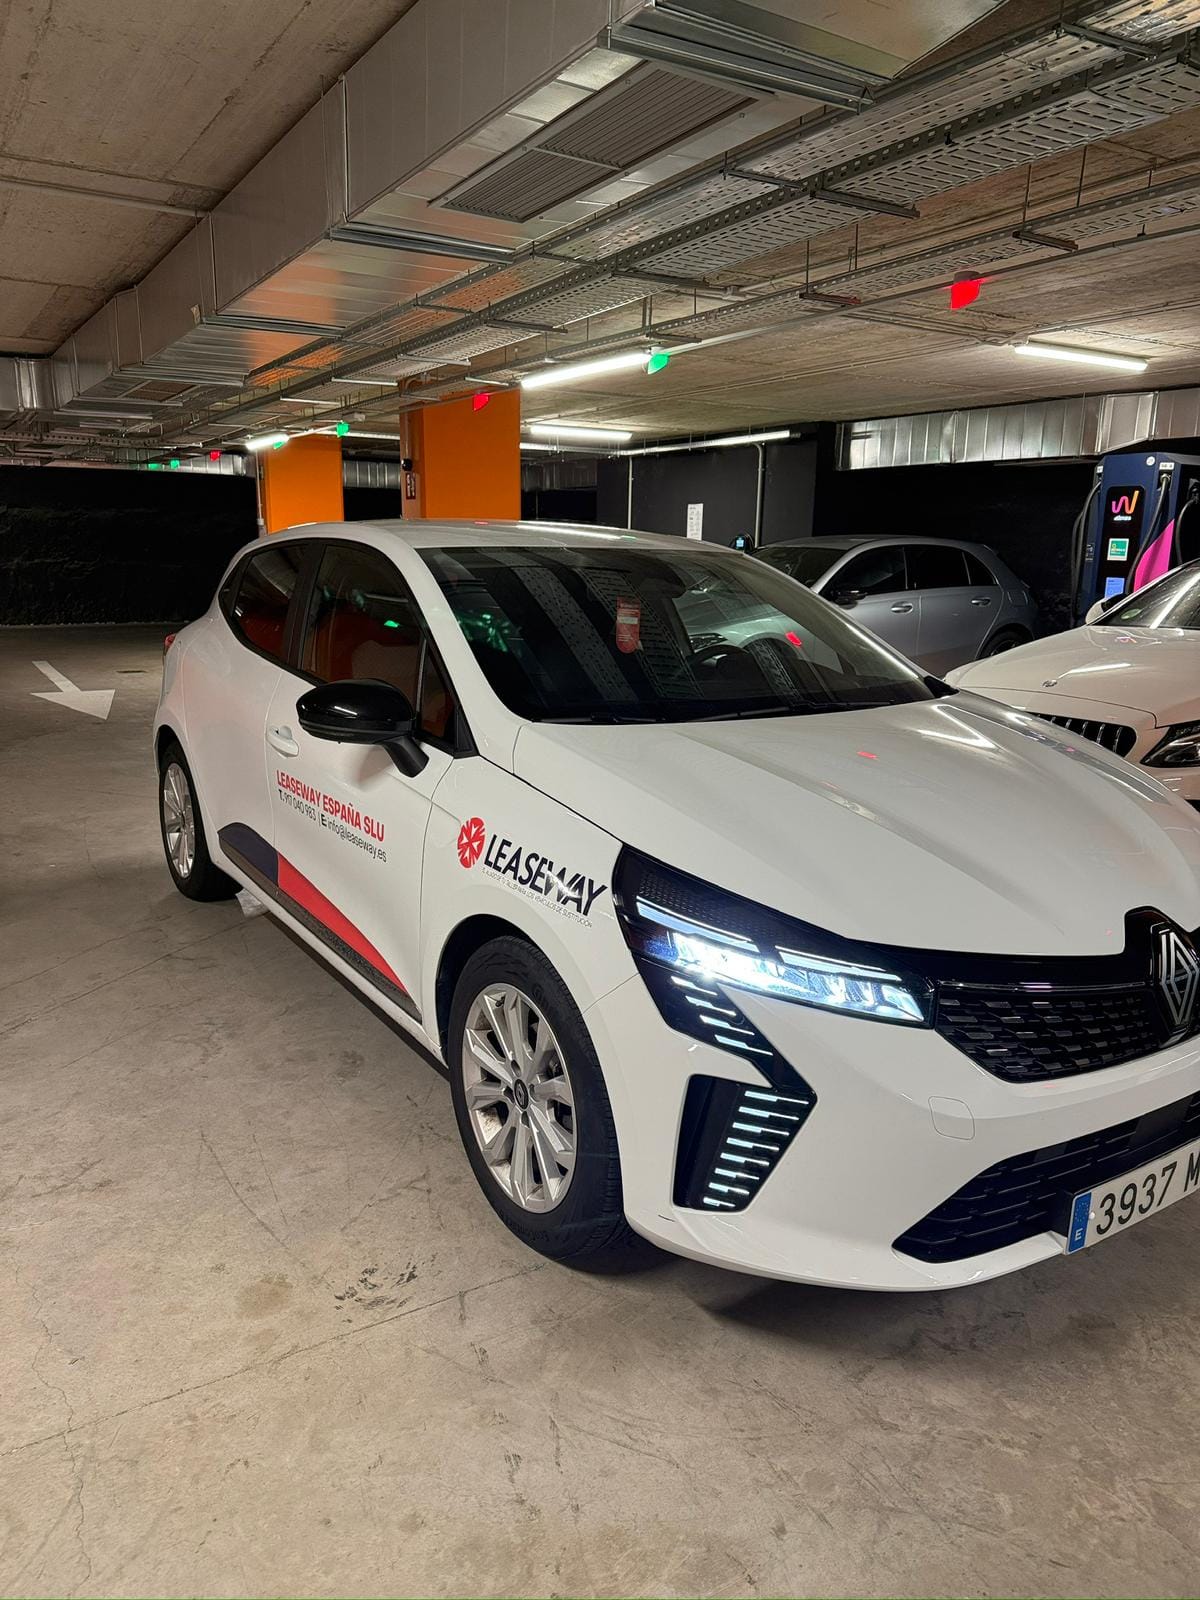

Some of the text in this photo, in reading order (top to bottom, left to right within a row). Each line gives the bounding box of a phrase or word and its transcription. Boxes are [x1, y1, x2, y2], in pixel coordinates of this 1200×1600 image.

[277, 769, 385, 842] LEASEWAY ESPAÑA SLU
[293, 797, 304, 814] 040
[484, 834, 608, 916] LEASEWAY
[1075, 1228, 1083, 1241] E
[1096, 1161, 1178, 1235] 3937
